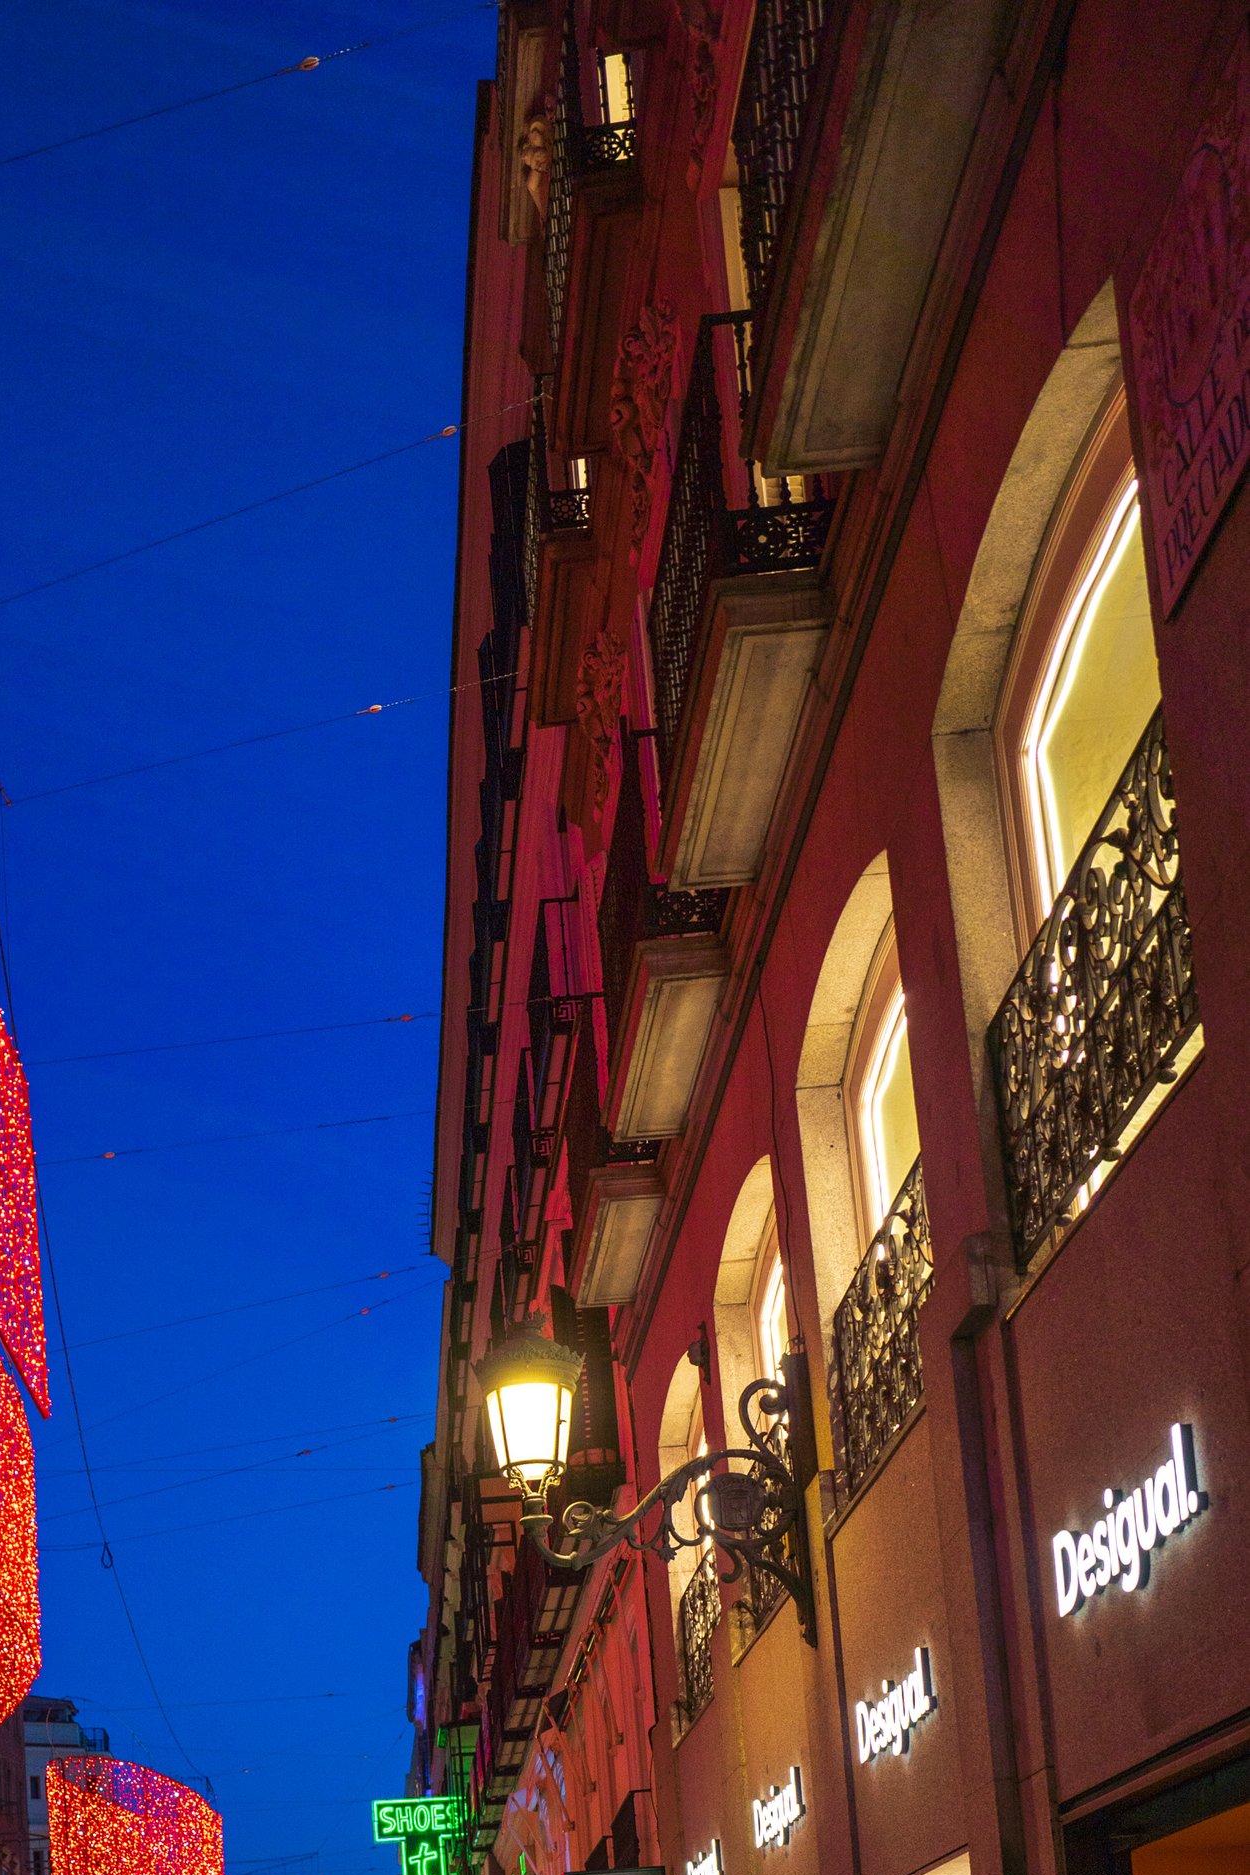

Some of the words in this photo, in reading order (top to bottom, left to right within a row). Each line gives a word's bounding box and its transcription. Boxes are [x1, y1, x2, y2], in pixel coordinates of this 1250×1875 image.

[1163, 352, 1226, 507] CALLE
[1052, 1422, 1199, 1618] Desigual.
[855, 1646, 931, 1764] Desigual.
[379, 1802, 459, 1834] SHOES
